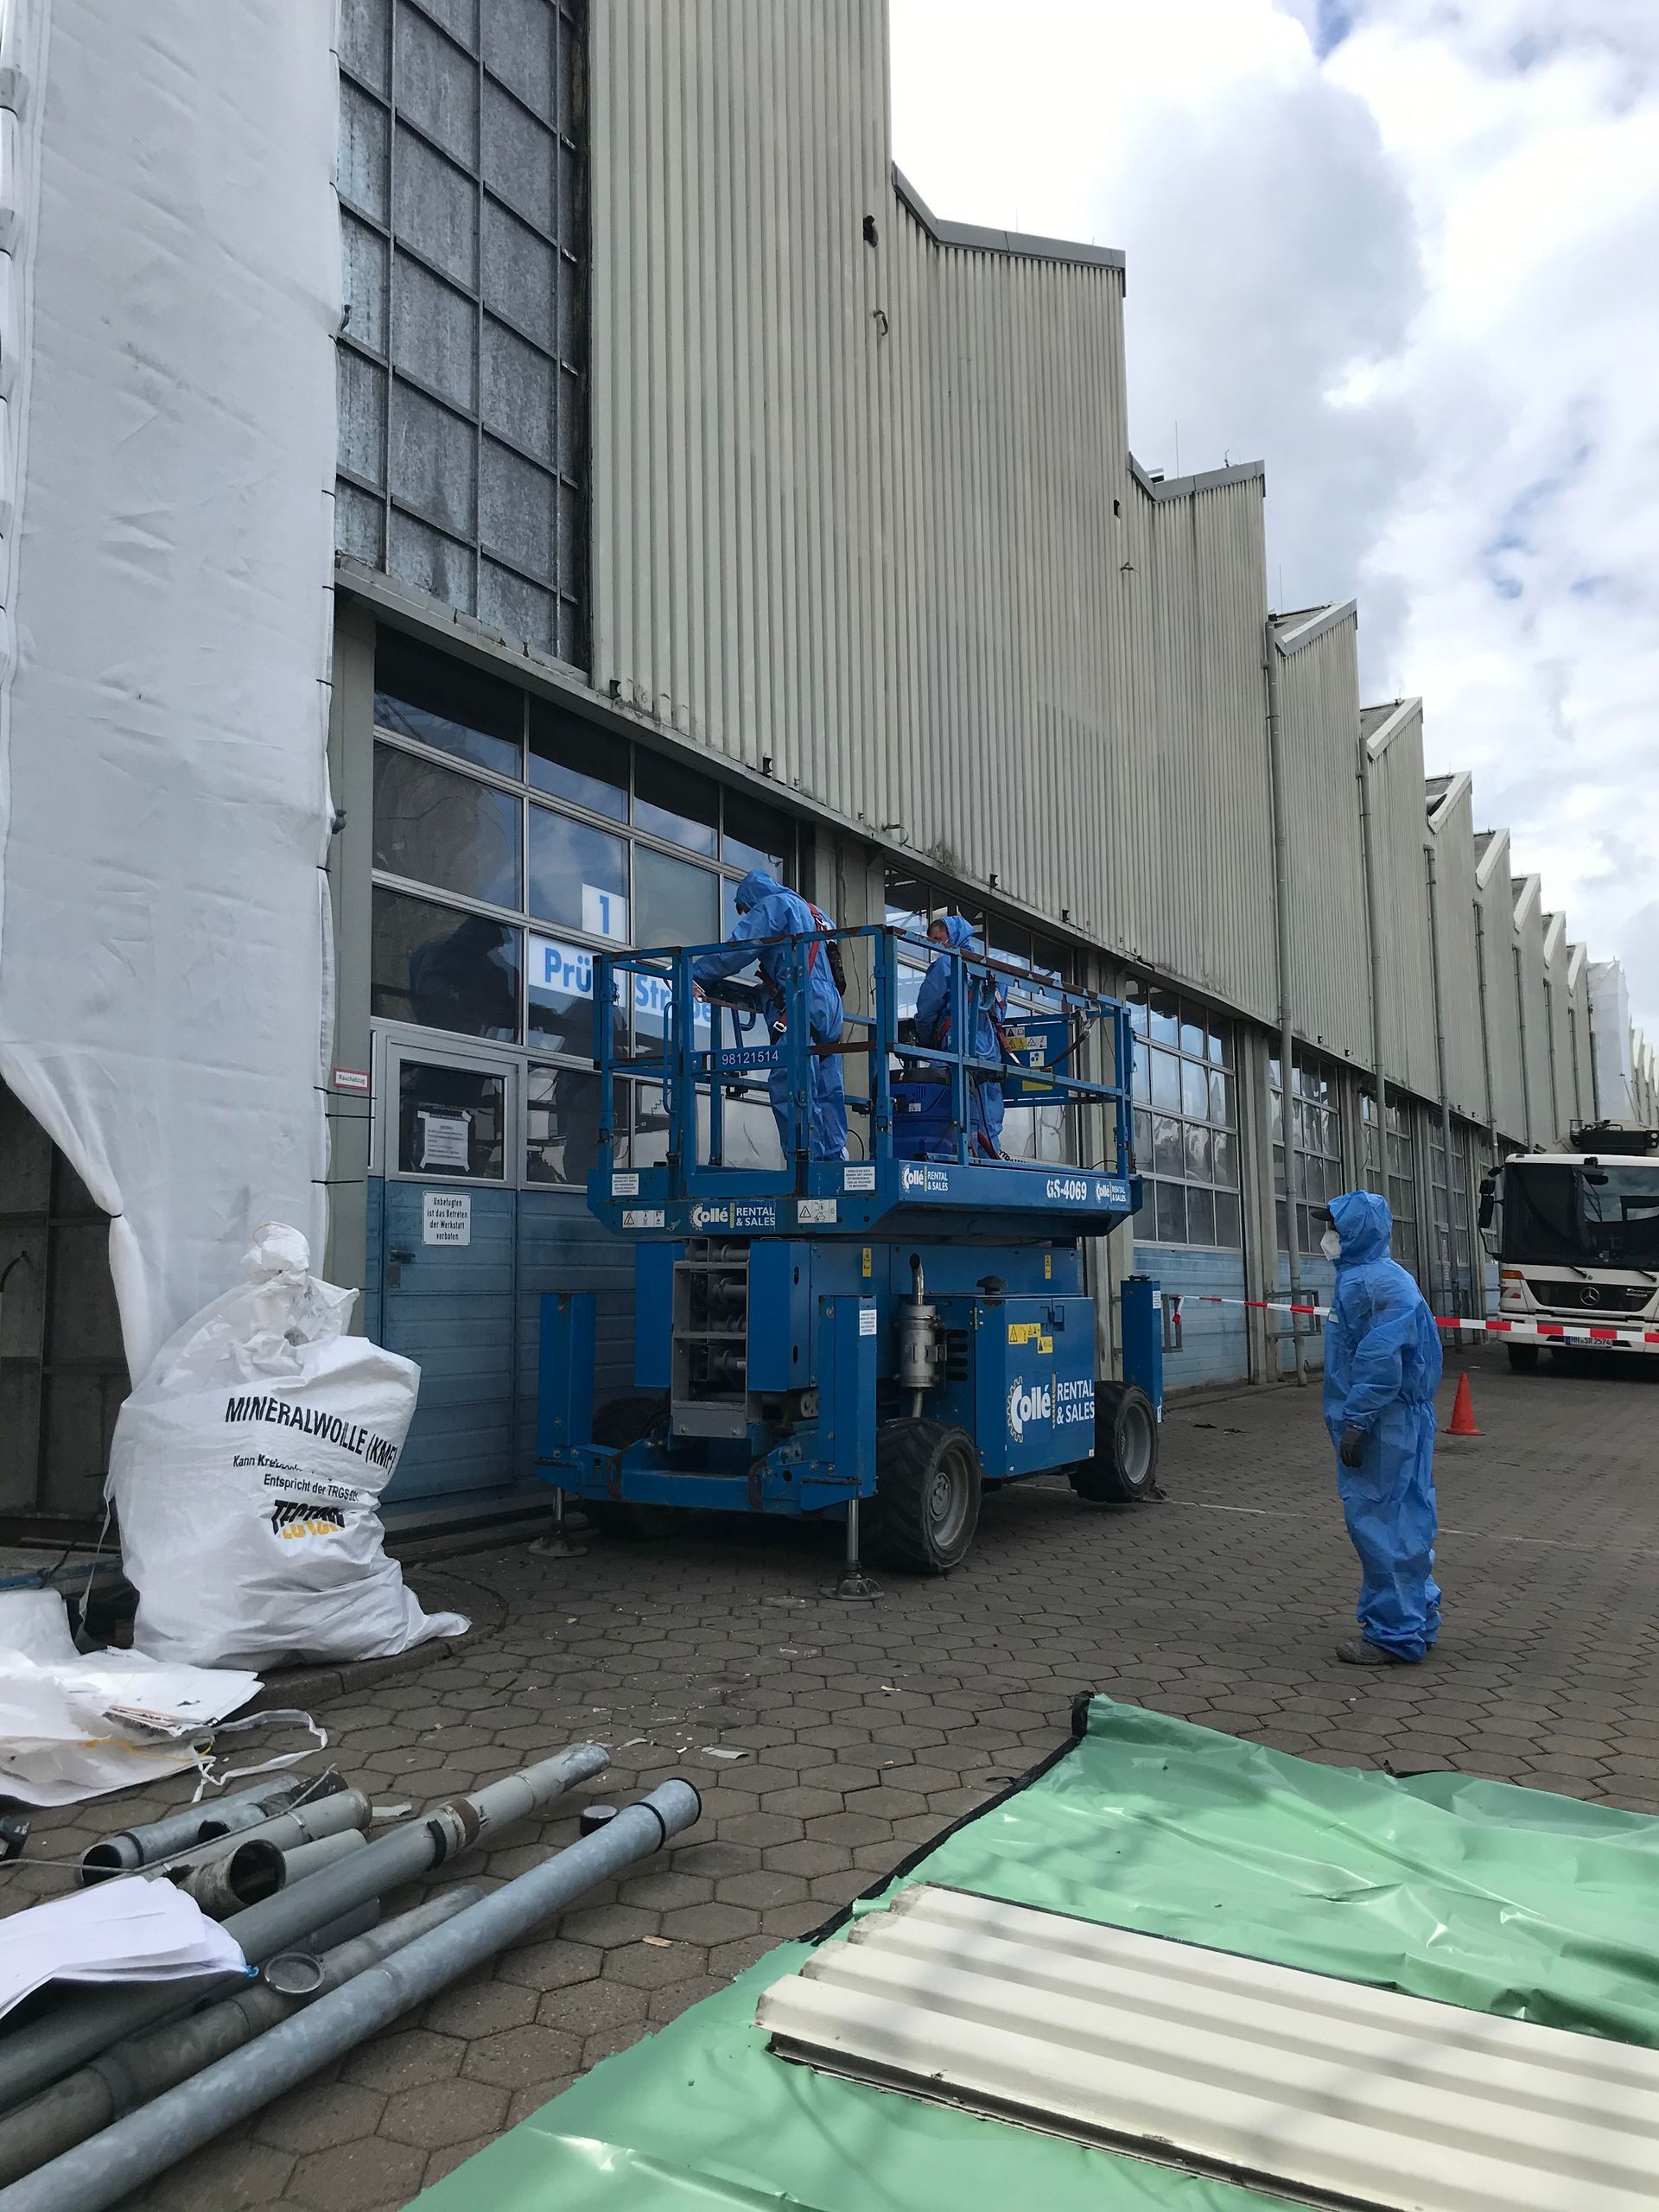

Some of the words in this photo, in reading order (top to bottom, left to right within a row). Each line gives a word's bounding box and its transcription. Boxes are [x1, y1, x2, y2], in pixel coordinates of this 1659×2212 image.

[599, 894, 610, 936] 1
[544, 947, 593, 993] Prü
[635, 974, 712, 1023] Stre
[721, 1050, 779, 1065] 98121514
[904, 1167, 924, 1189] Collé
[927, 1171, 949, 1181] RENTAL
[932, 1181, 949, 1192] SALES
[1046, 1179, 1087, 1201] GS-4069
[1111, 1185, 1126, 1194] RENTAL
[433, 1197, 462, 1208] Unbefugten
[435, 1209, 445, 1217] das
[446, 1209, 467, 1218] Betreten
[692, 1206, 728, 1228] Collé
[736, 1206, 775, 1217] RENTAL
[736, 1218, 743, 1227] &
[745, 1217, 775, 1227] SALES
[429, 1219, 439, 1228] der
[440, 1220, 465, 1230] Werkstatt
[435, 1231, 459, 1240] verboten
[1010, 1384, 1052, 1434] Collé
[1057, 1379, 1095, 1402] RENTAL
[1056, 1406, 1065, 1425] &
[1065, 1401, 1096, 1423] SALES
[225, 1396, 368, 1455] MINERALWOLLE
[232, 1455, 255, 1468] Kann
[264, 1473, 311, 1493] Entspricht
[312, 1482, 327, 1495] der
